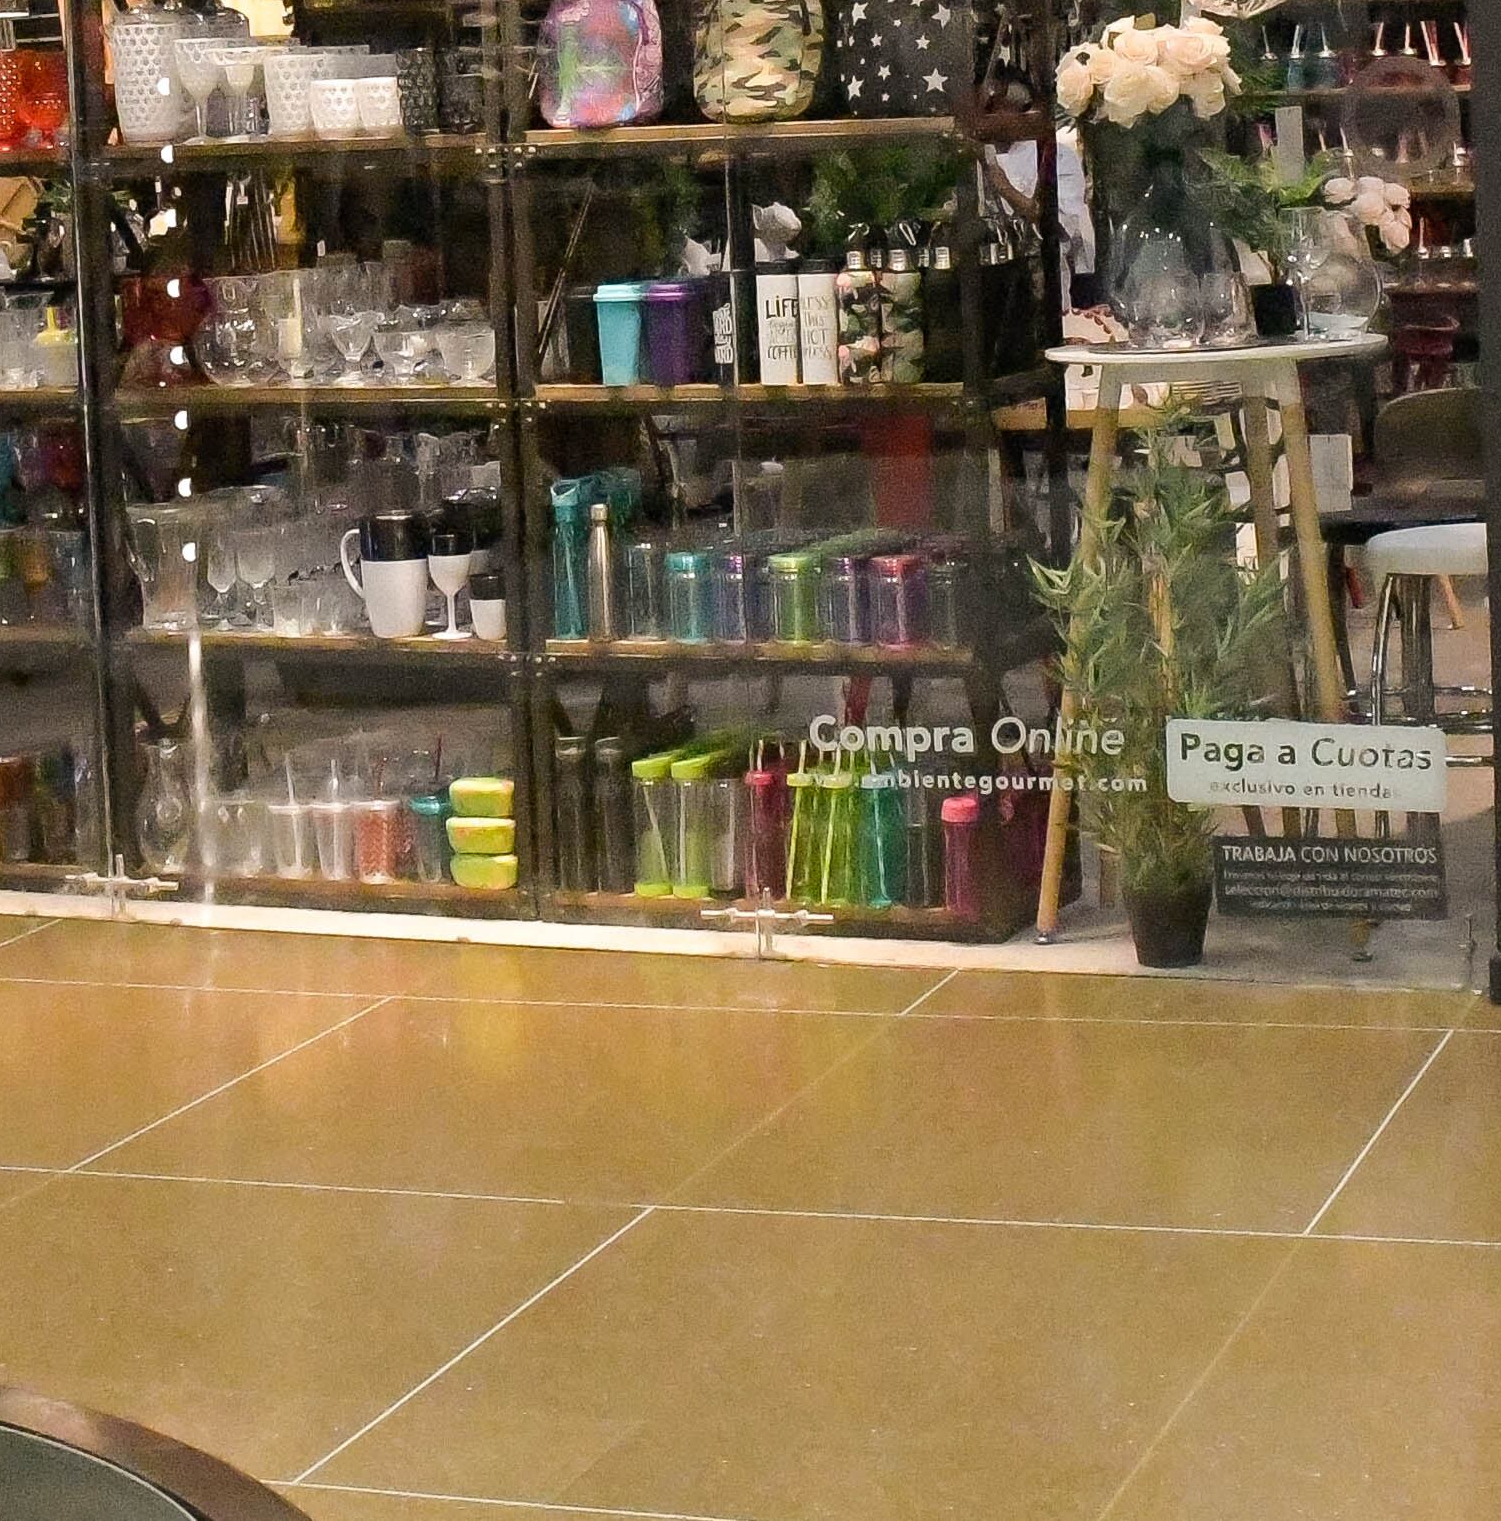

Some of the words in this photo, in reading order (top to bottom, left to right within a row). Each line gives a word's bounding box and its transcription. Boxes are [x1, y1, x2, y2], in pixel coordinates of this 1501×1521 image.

[809, 714, 975, 762] Compra
[991, 716, 1126, 756] Online
[1181, 732, 1265, 772] Paga
[1277, 743, 1296, 765] a
[1311, 737, 1432, 770] Cuotas
[1209, 778, 1296, 795] exclusivo
[1303, 783, 1325, 796] en
[1222, 845, 1297, 863] TRABAJA
[1301, 846, 1339, 863] CON
[1344, 846, 1438, 865] NOSOTROS
